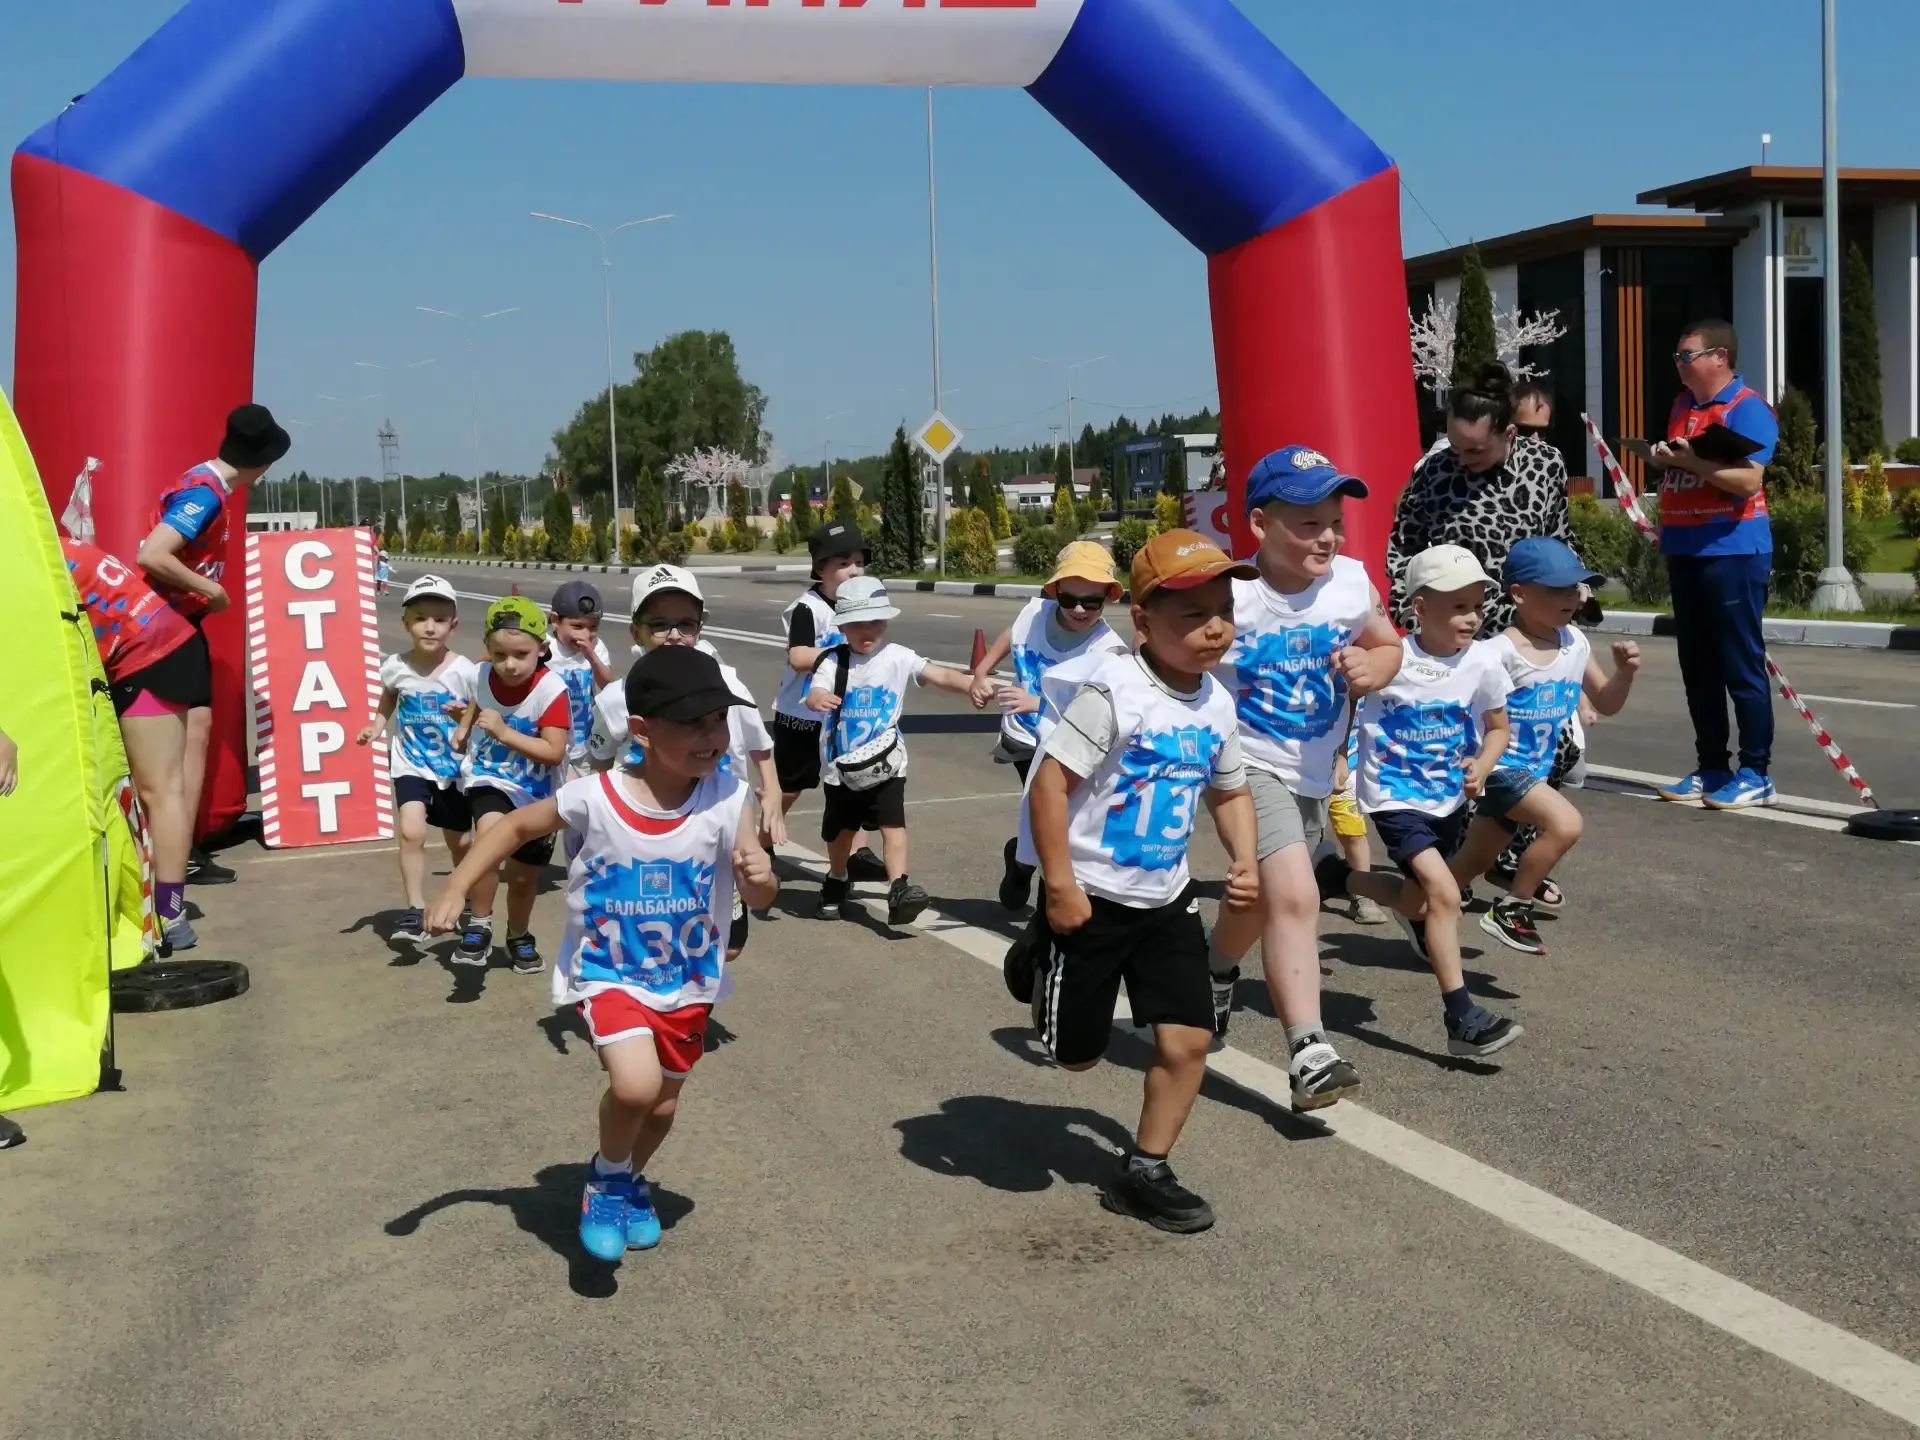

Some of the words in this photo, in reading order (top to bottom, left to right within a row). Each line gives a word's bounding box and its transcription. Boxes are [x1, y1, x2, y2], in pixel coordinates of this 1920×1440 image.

[647, 576, 679, 588] adidas
[284, 540, 351, 833] СТАРТ
[837, 719, 884, 752] 12
[1507, 717, 1572, 759] 13
[598, 913, 711, 969] 130
